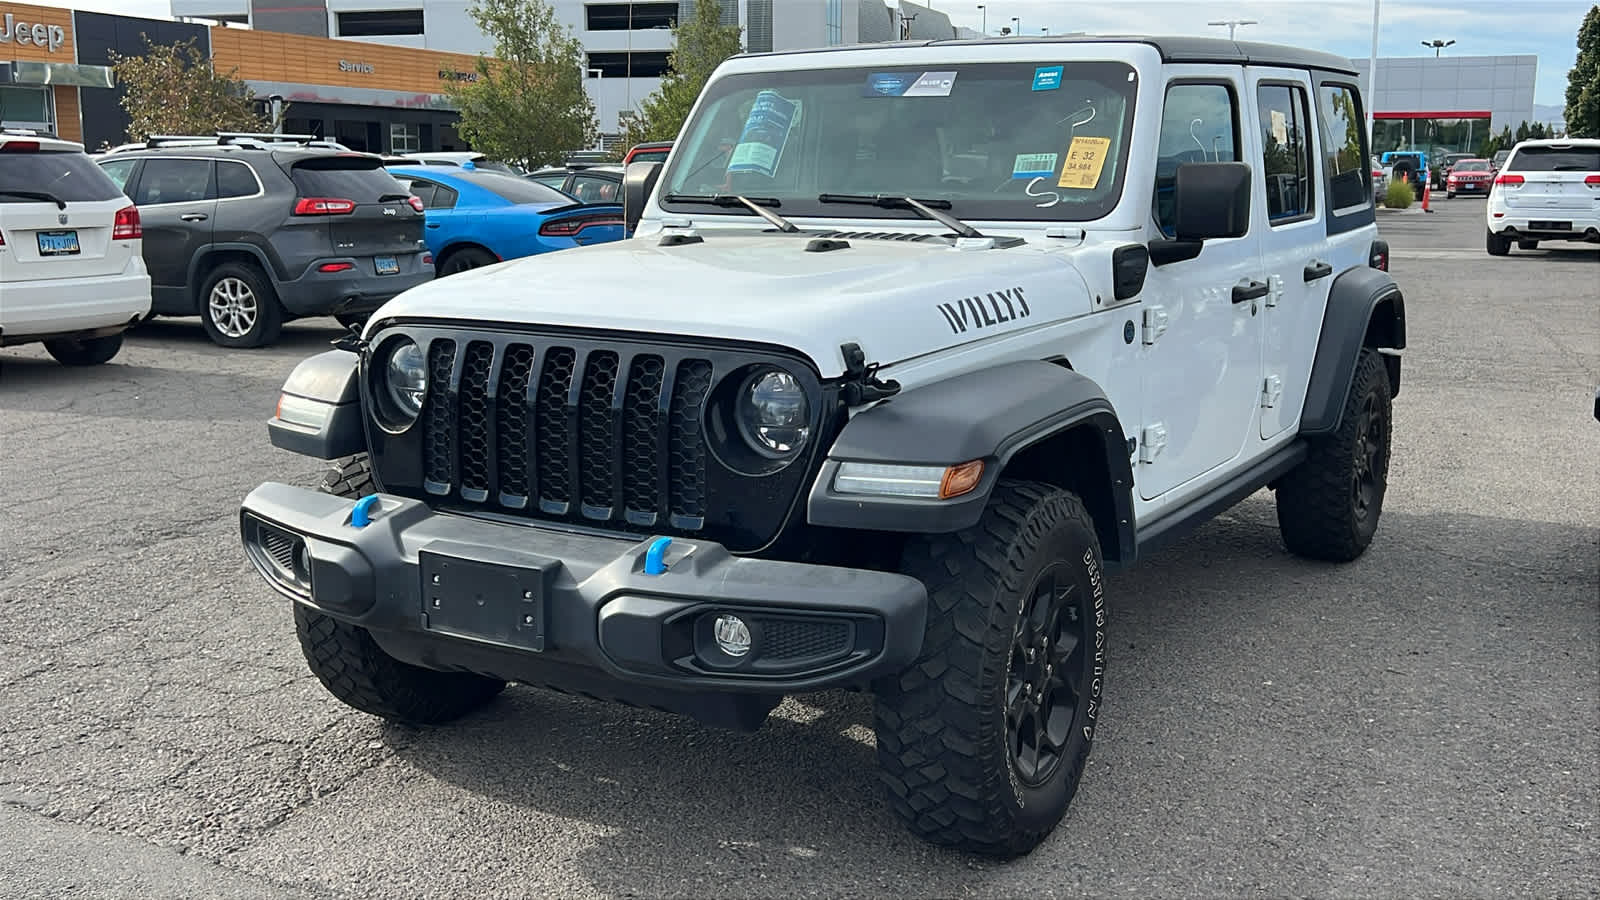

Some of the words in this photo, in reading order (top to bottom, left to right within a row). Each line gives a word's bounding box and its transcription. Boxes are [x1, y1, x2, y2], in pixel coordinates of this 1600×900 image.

[0, 13, 65, 53] Jeep
[339, 60, 375, 74] Service
[936, 286, 1030, 334] WILLYS
[1082, 547, 1105, 720] DESTINATION
